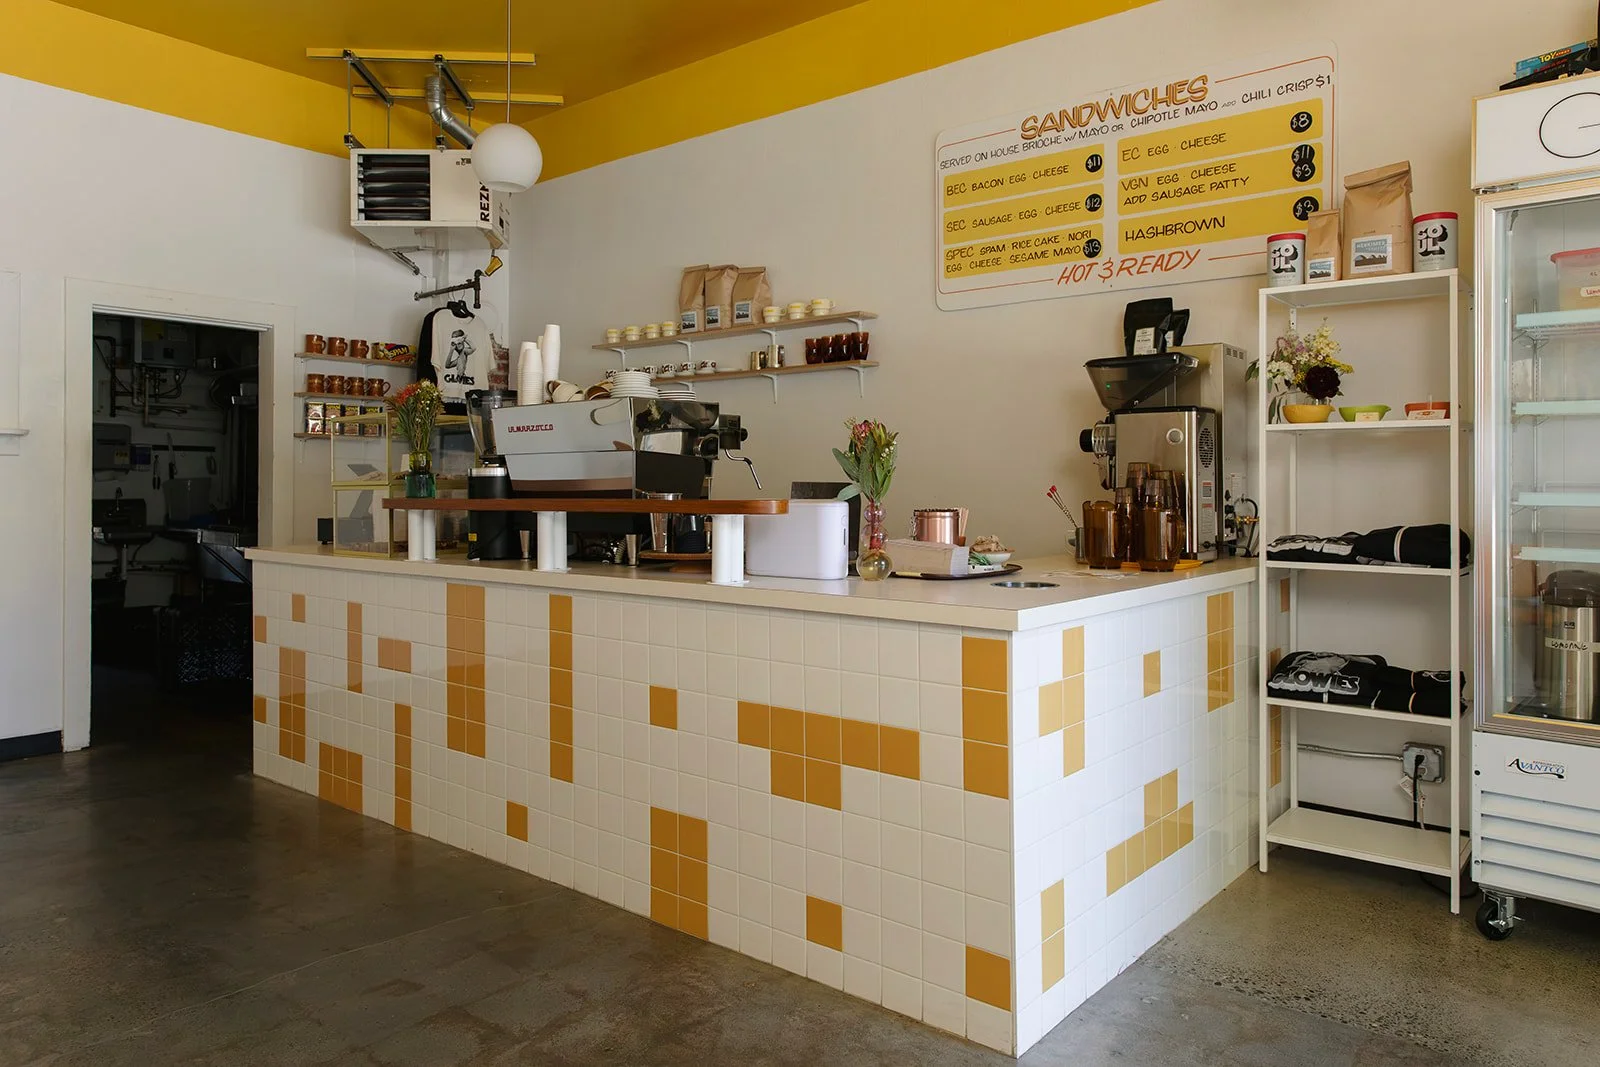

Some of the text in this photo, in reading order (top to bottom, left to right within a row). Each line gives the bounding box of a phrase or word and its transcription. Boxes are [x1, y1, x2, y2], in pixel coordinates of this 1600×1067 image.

[1540, 52, 1556, 62] TOY
[1021, 74, 1208, 140] SANDWICHES
[1292, 112, 1310, 129] $8
[940, 155, 972, 170] SERVED
[974, 152, 988, 162] ON
[990, 144, 1020, 158] HOUSE
[1022, 135, 1062, 152] BRIOCHE
[1078, 125, 1109, 140] MAYO
[1111, 124, 1124, 132] OR
[1130, 108, 1180, 128] CHIPOTLE
[1185, 101, 1218, 116] MAYO
[1242, 89, 1272, 104] CHILI
[1276, 78, 1314, 96] CRISP
[1122, 133, 1228, 162] EC EGG CHEESE
[1292, 146, 1310, 162] $11
[946, 165, 1070, 196] BEC BACON EGG CHEESE
[1121, 163, 1237, 192] VGN EGG CHEESE
[1294, 163, 1312, 178] $3
[1124, 176, 1250, 206] ADD SAUSAGE PATTY
[946, 202, 1081, 233] SEC SAUSAGE EGG CHEESE
[1296, 200, 1314, 219] $3
[1126, 216, 1226, 242] HASHBROWN
[946, 230, 1092, 261] SPEC SPAM RICE CAKE NORI
[946, 246, 1081, 274] EGG CHEESE SESAME MAYO
[1057, 262, 1098, 286] HOT
[1116, 249, 1200, 278] READY
